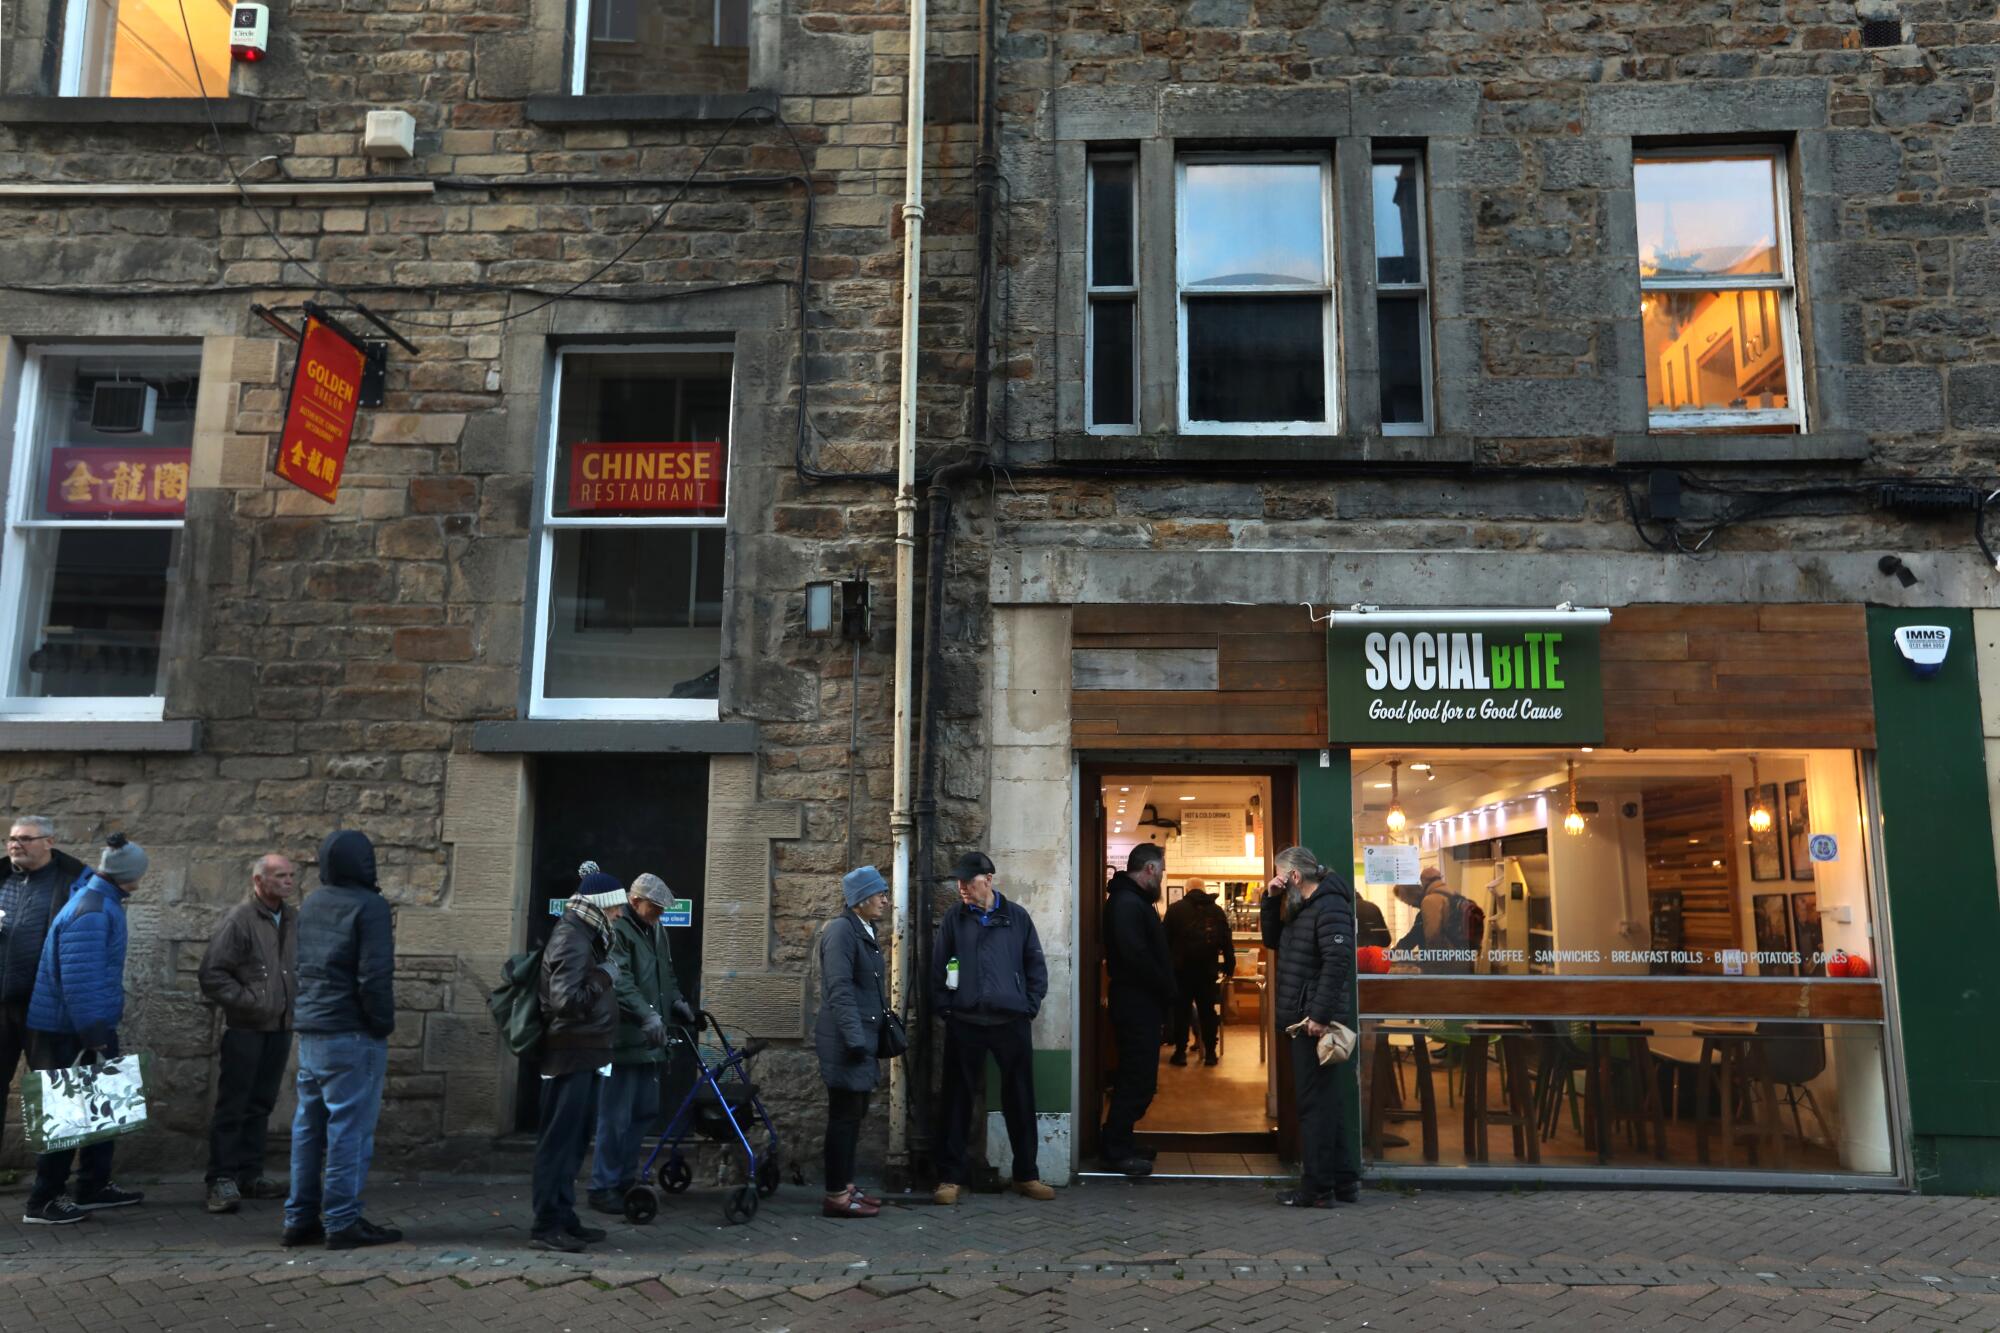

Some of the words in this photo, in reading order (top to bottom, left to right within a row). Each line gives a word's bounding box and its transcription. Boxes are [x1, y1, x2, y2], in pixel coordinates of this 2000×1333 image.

[307, 359, 354, 402] GOLDEN
[314, 384, 344, 411] DRAGON
[582, 452, 711, 480] CHINESE
[61, 461, 190, 502] 金龍閣
[581, 483, 706, 502] RESTAURANT
[1906, 630, 1946, 640] IMMS
[1364, 632, 1490, 690] SOCIAL
[1369, 698, 1406, 720] Good
[1407, 700, 1440, 724] food
[1442, 700, 1464, 724] for
[1466, 706, 1477, 720] a
[1480, 698, 1518, 720] Good
[1520, 698, 1563, 720] Cause
[1381, 949, 1416, 962] SOCIAL
[1418, 949, 1477, 962] ENTERPRISE
[1488, 950, 1524, 962] COFFEE
[1535, 950, 1600, 963] SANDWICHES
[1611, 950, 1669, 963] BREAKFAST
[1671, 950, 1703, 963] ROLLS
[1750, 951, 1802, 964] POTATOES
[1812, 951, 1848, 964] CAKES
